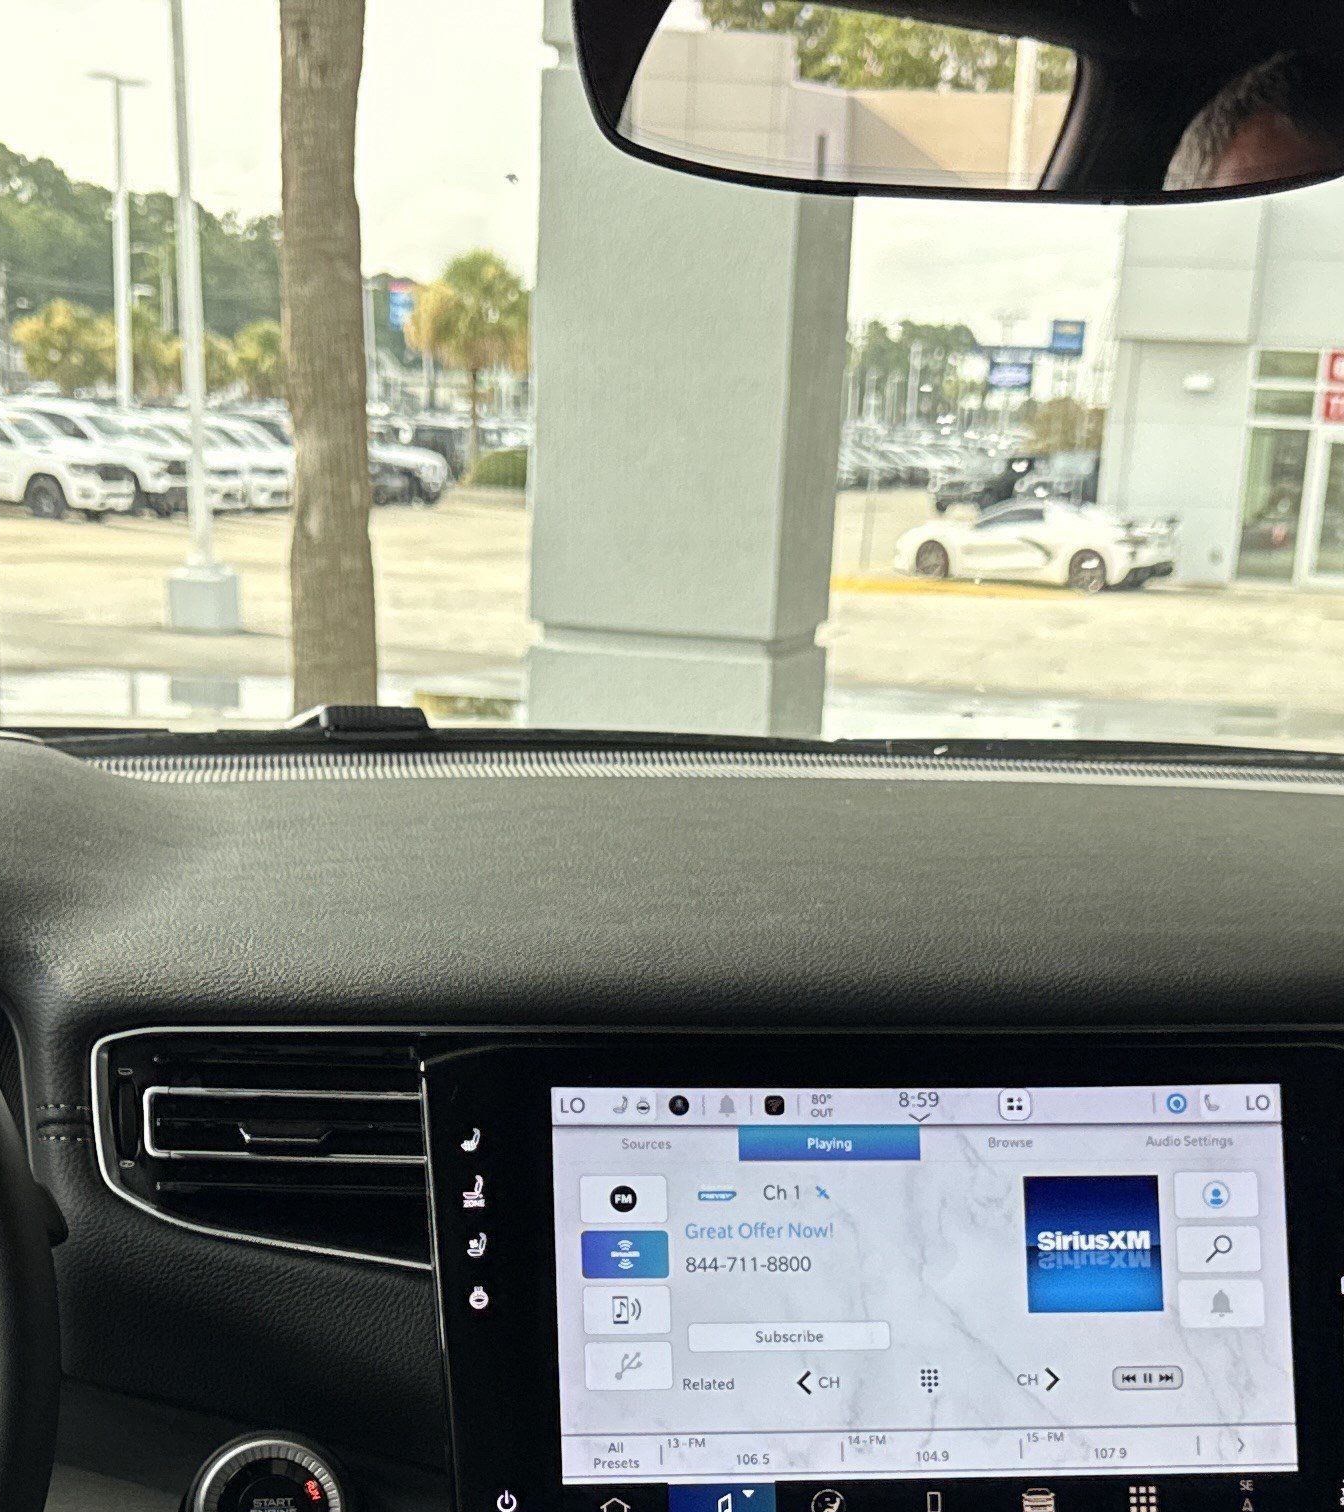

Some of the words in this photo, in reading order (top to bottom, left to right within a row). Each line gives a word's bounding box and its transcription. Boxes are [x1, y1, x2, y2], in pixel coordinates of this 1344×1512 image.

[560, 1097, 586, 1114] LO
[898, 1091, 940, 1108] 8:59
[1245, 1094, 1271, 1111] LO
[810, 1108, 834, 1118] OUT
[621, 1138, 672, 1150] Sources
[807, 1137, 853, 1152] Playing
[987, 1136, 1033, 1149] Browse
[1145, 1135, 1181, 1147] Audio
[1183, 1135, 1234, 1149] Settings
[614, 1194, 633, 1204] FM
[762, 1185, 788, 1200] Ch
[794, 1185, 801, 1200] 1
[684, 1223, 733, 1240] Great
[738, 1222, 786, 1239] Offer
[788, 1222, 834, 1238] Now!
[1037, 1230, 1151, 1251] SiriusXM
[685, 1256, 812, 1273] 844-711-8800
[755, 1330, 824, 1343] Subscribe
[682, 1377, 735, 1391] Related
[818, 1376, 841, 1390] CH
[1016, 1373, 1039, 1386] CH
[607, 1442, 624, 1454] All
[593, 1457, 640, 1469] Presets
[915, 1450, 950, 1462] 104.9
[252, 1498, 293, 1507] START
